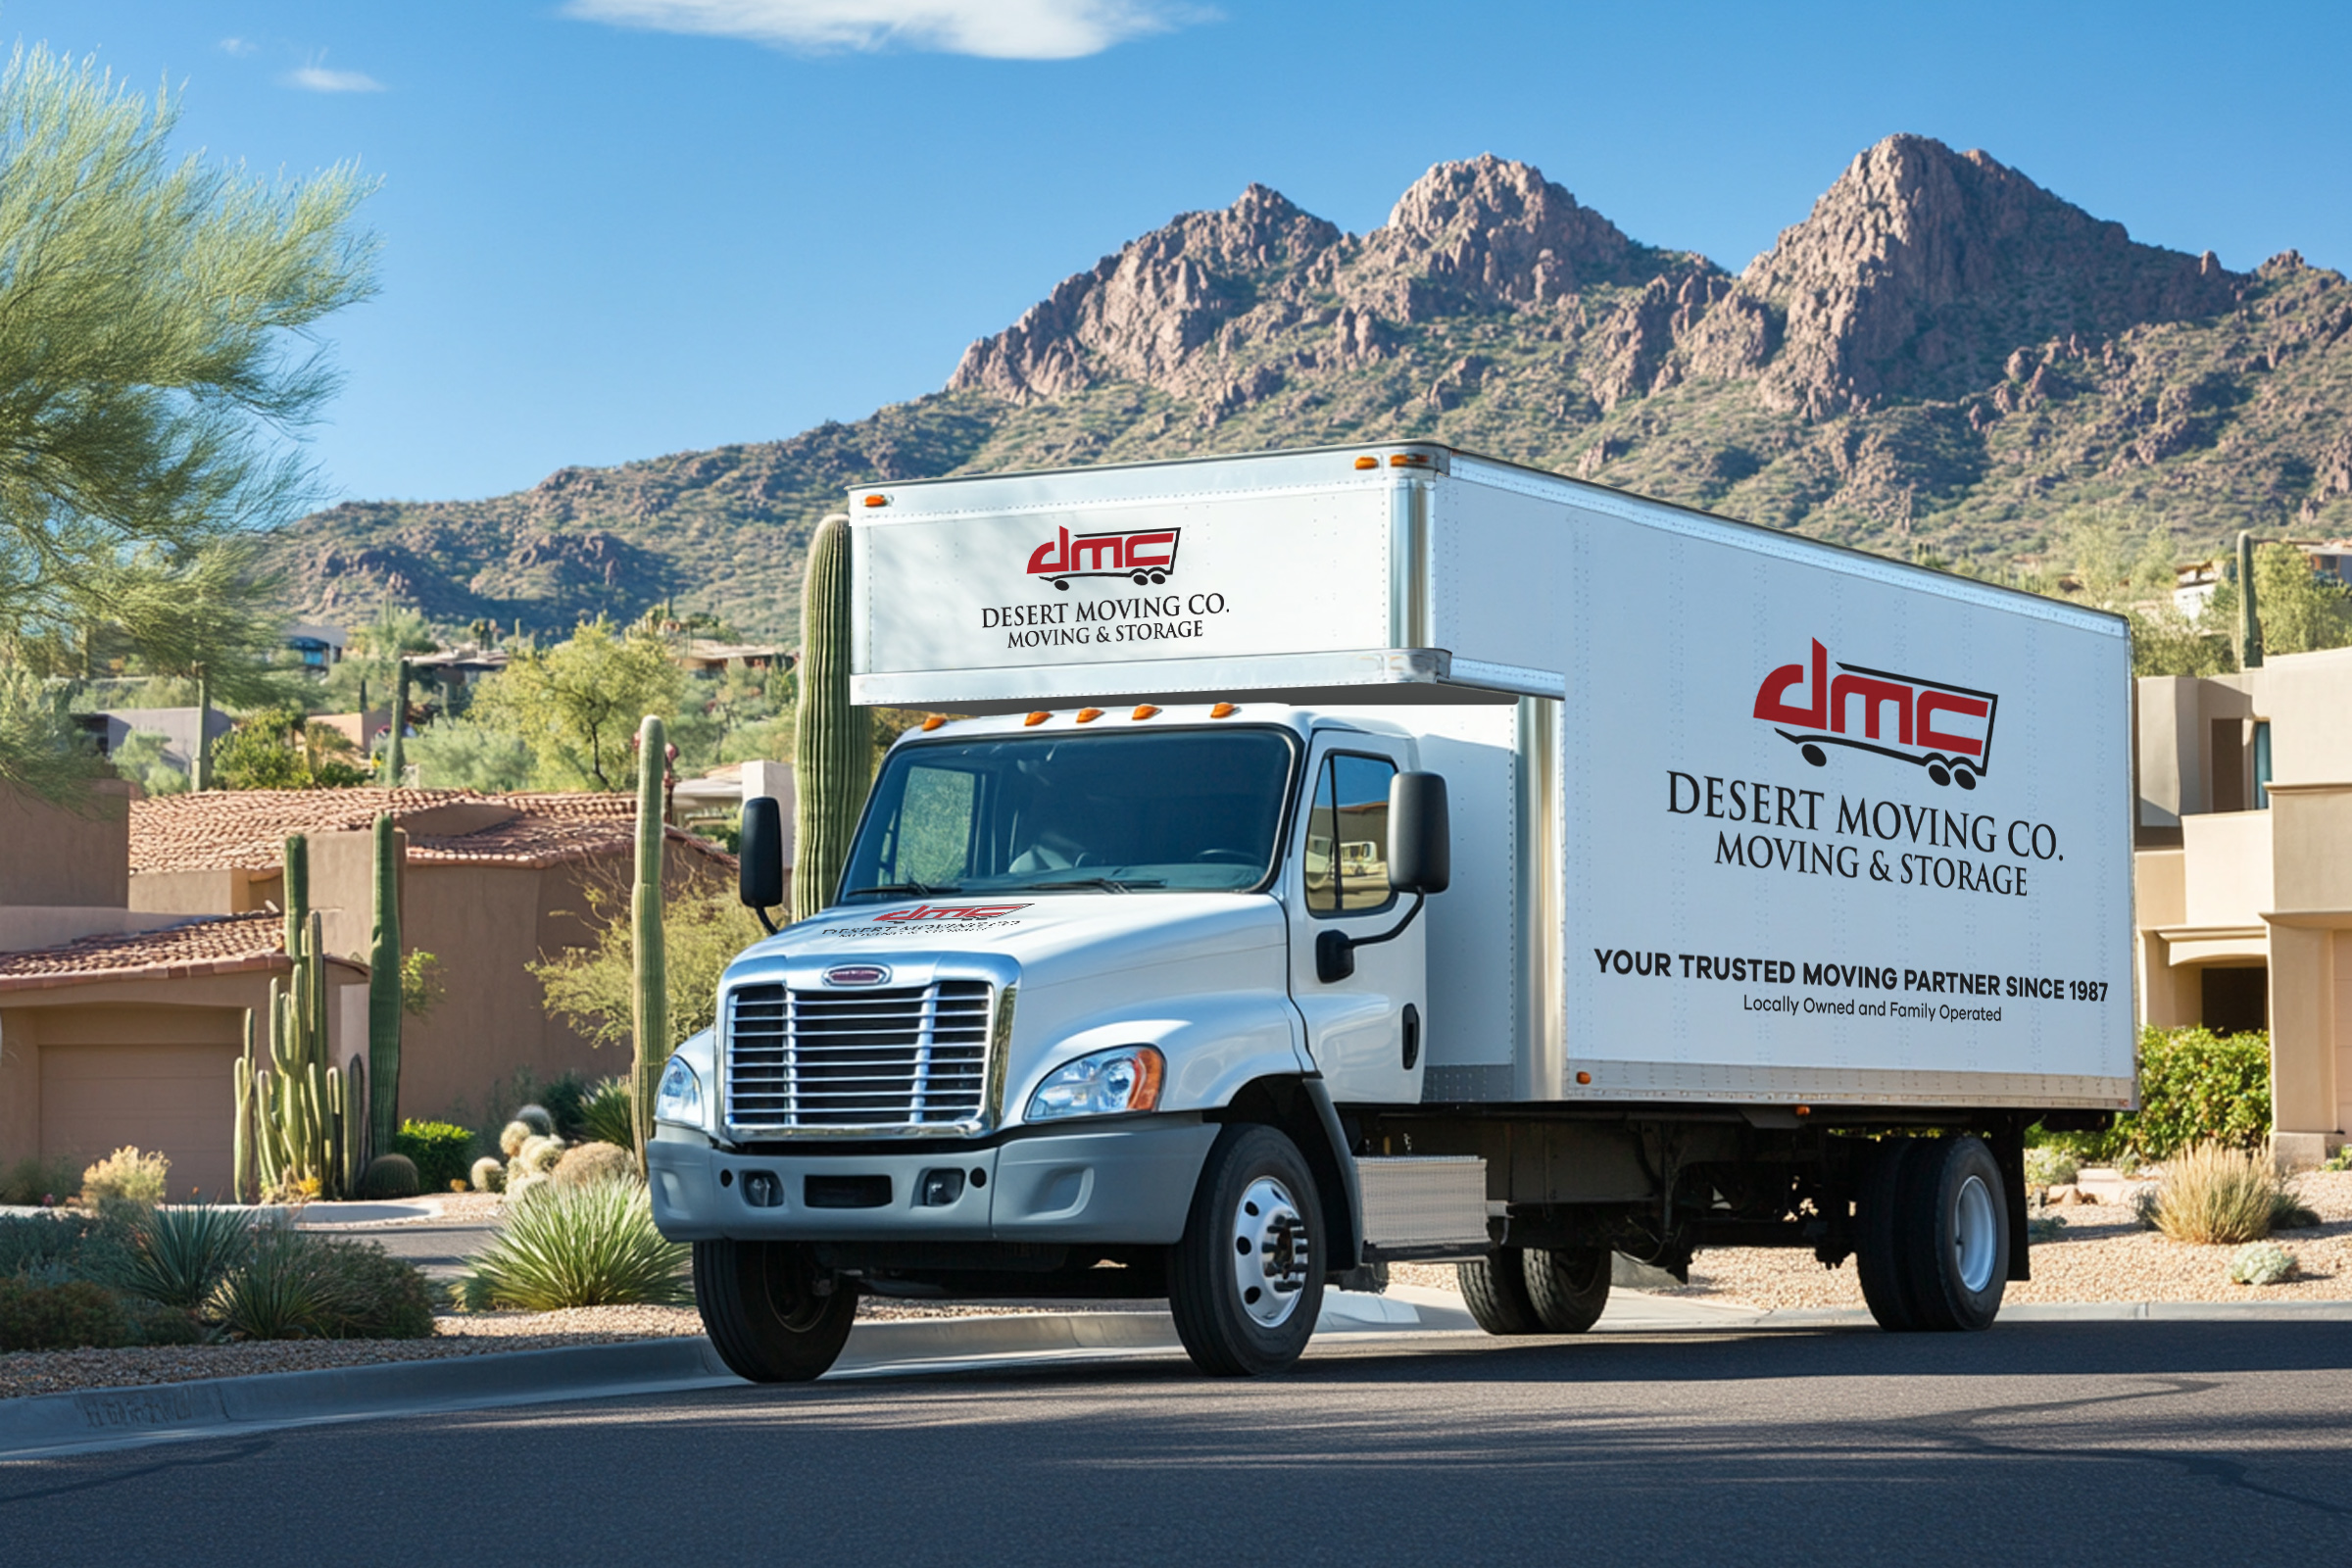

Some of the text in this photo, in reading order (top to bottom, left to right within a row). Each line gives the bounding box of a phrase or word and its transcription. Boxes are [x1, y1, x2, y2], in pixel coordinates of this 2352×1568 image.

[1026, 525, 1175, 574] dmc
[981, 593, 1230, 628] DESERT MOVING CO.
[1007, 620, 1203, 649] MOVING & STORAGE
[1752, 637, 1990, 757] dmc
[1666, 770, 2064, 861] DESERT MOVING CO.
[1714, 830, 2028, 897] MOVING & STORAGE
[1593, 948, 2109, 1003] YOUR TRUSTED MOVING PARTNER SINCE 1987
[1743, 994, 2002, 1023] Locally Owned and Family Operated
